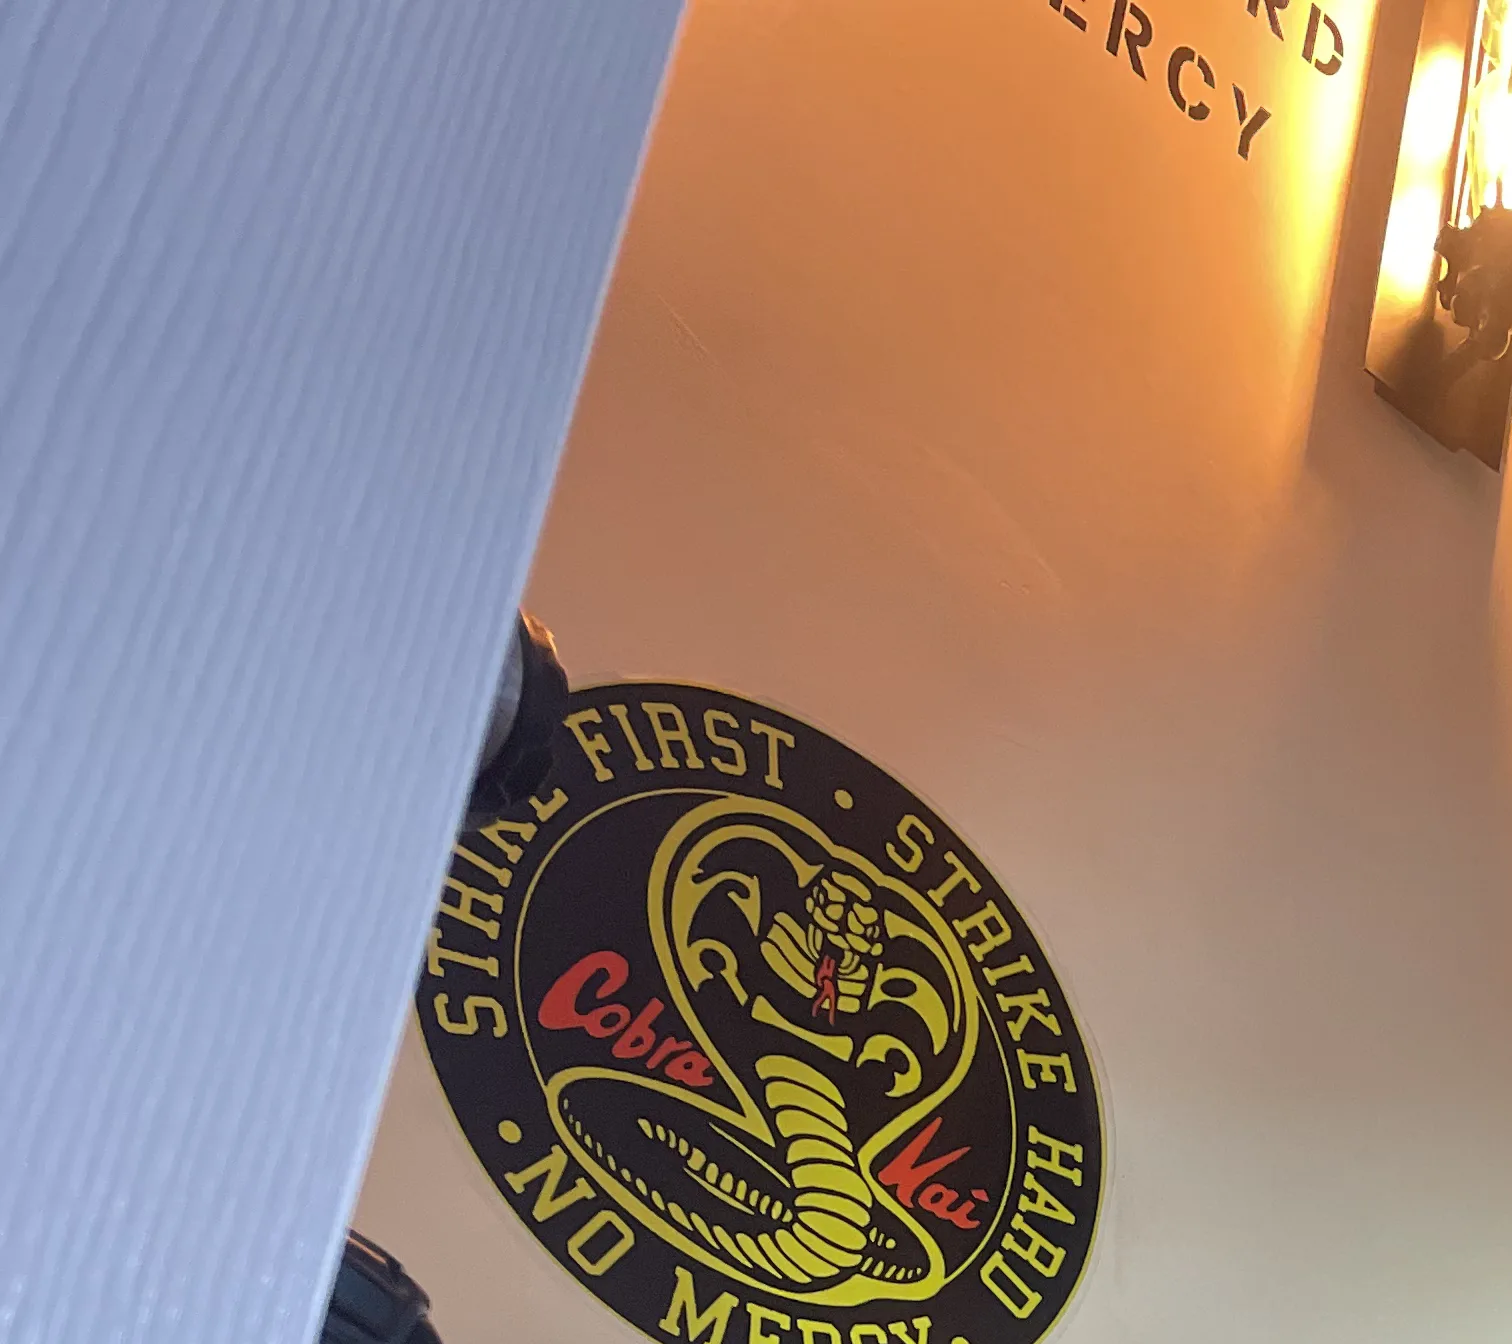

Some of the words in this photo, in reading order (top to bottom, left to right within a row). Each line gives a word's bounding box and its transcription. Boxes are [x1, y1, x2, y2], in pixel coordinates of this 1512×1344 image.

[561, 701, 796, 791] FIRST
[538, 950, 715, 1088] Cobra
[884, 813, 1079, 1097] STRIKE
[505, 1144, 636, 1278] NO
[979, 1126, 1085, 1321] HARD
